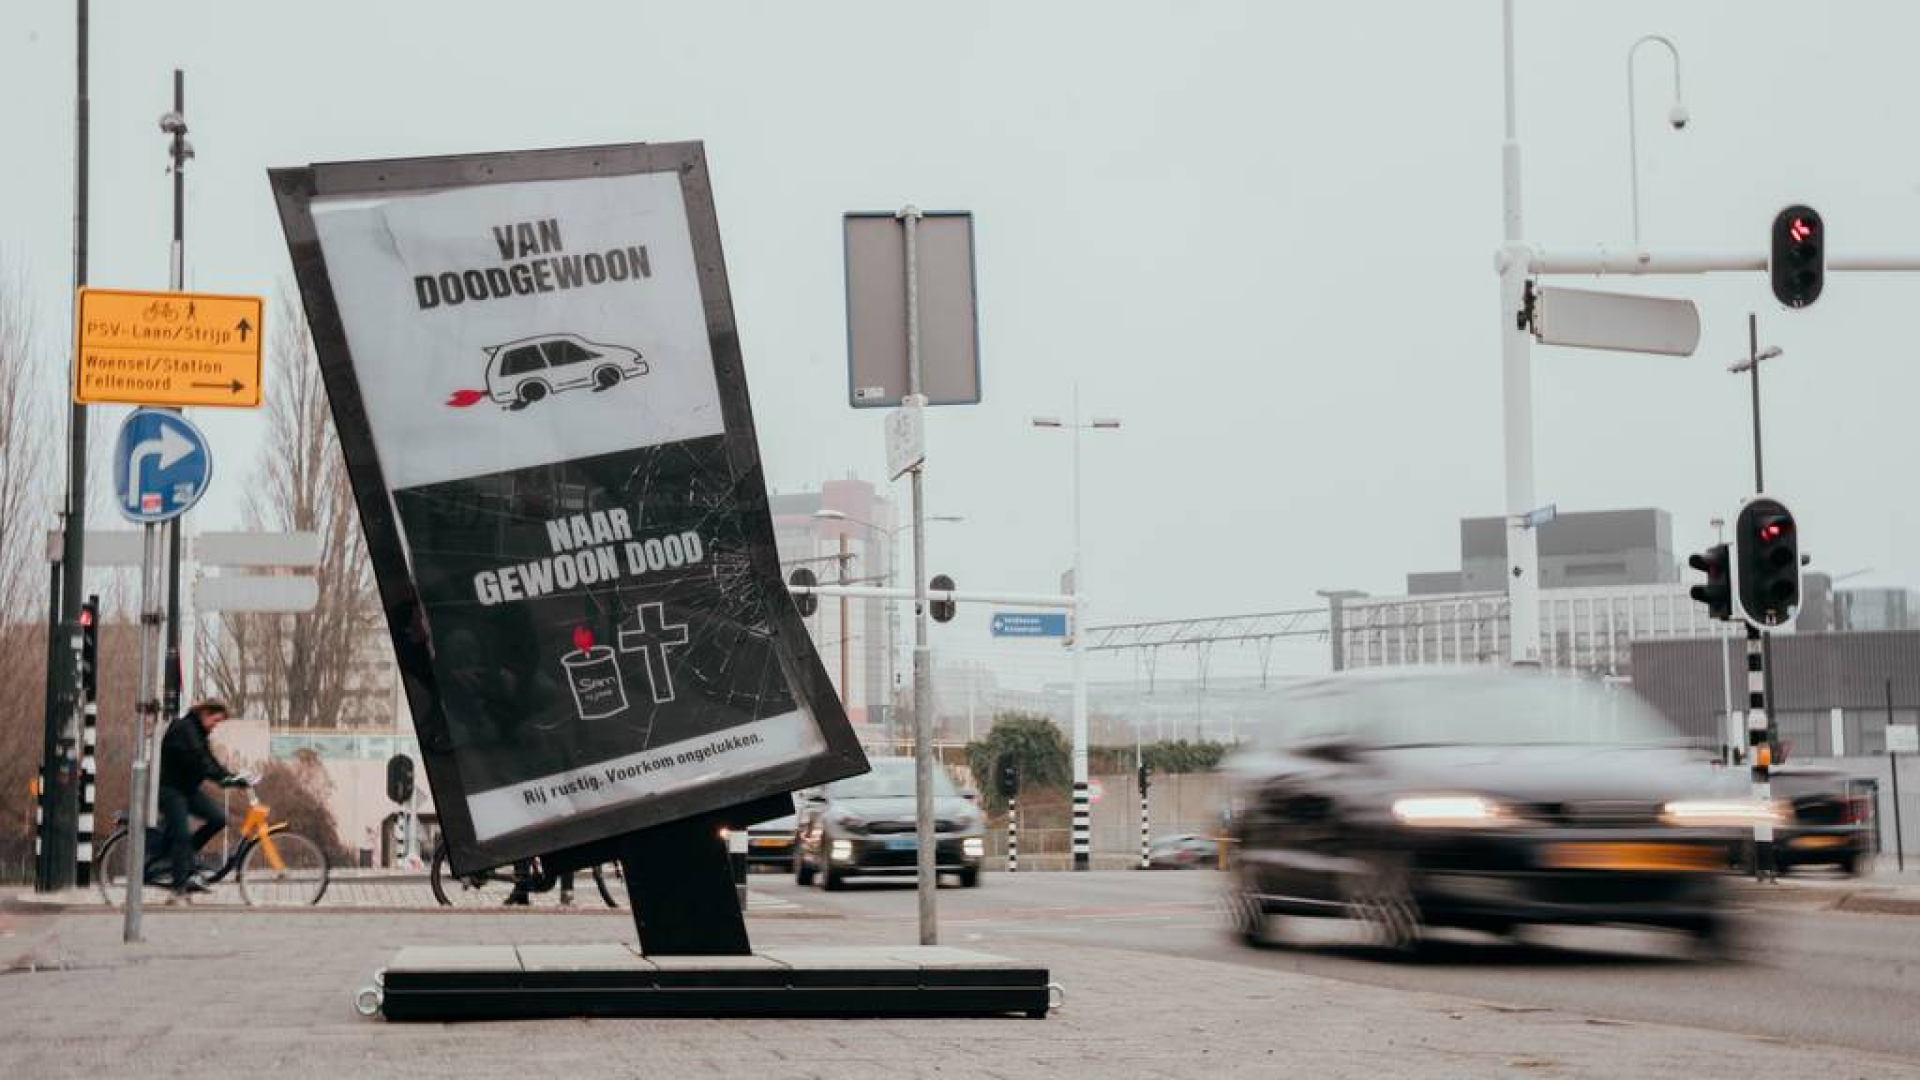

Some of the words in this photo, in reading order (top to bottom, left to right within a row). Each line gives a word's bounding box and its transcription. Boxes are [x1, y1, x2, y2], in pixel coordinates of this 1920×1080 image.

[493, 218, 563, 261] VAN
[413, 245, 652, 310] DOODGEWOON
[87, 321, 231, 345] PSV-Laan/Strijp
[85, 374, 172, 391] Fellenoord
[86, 355, 223, 374] Woensel/Station
[545, 508, 633, 552] NAAR
[474, 546, 620, 607] GEWOON
[624, 531, 704, 576] DOOD
[523, 788, 547, 805] Rij
[549, 774, 604, 799] rustig.
[605, 755, 675, 785] Voorkom
[676, 732, 764, 766] ongelukken.
